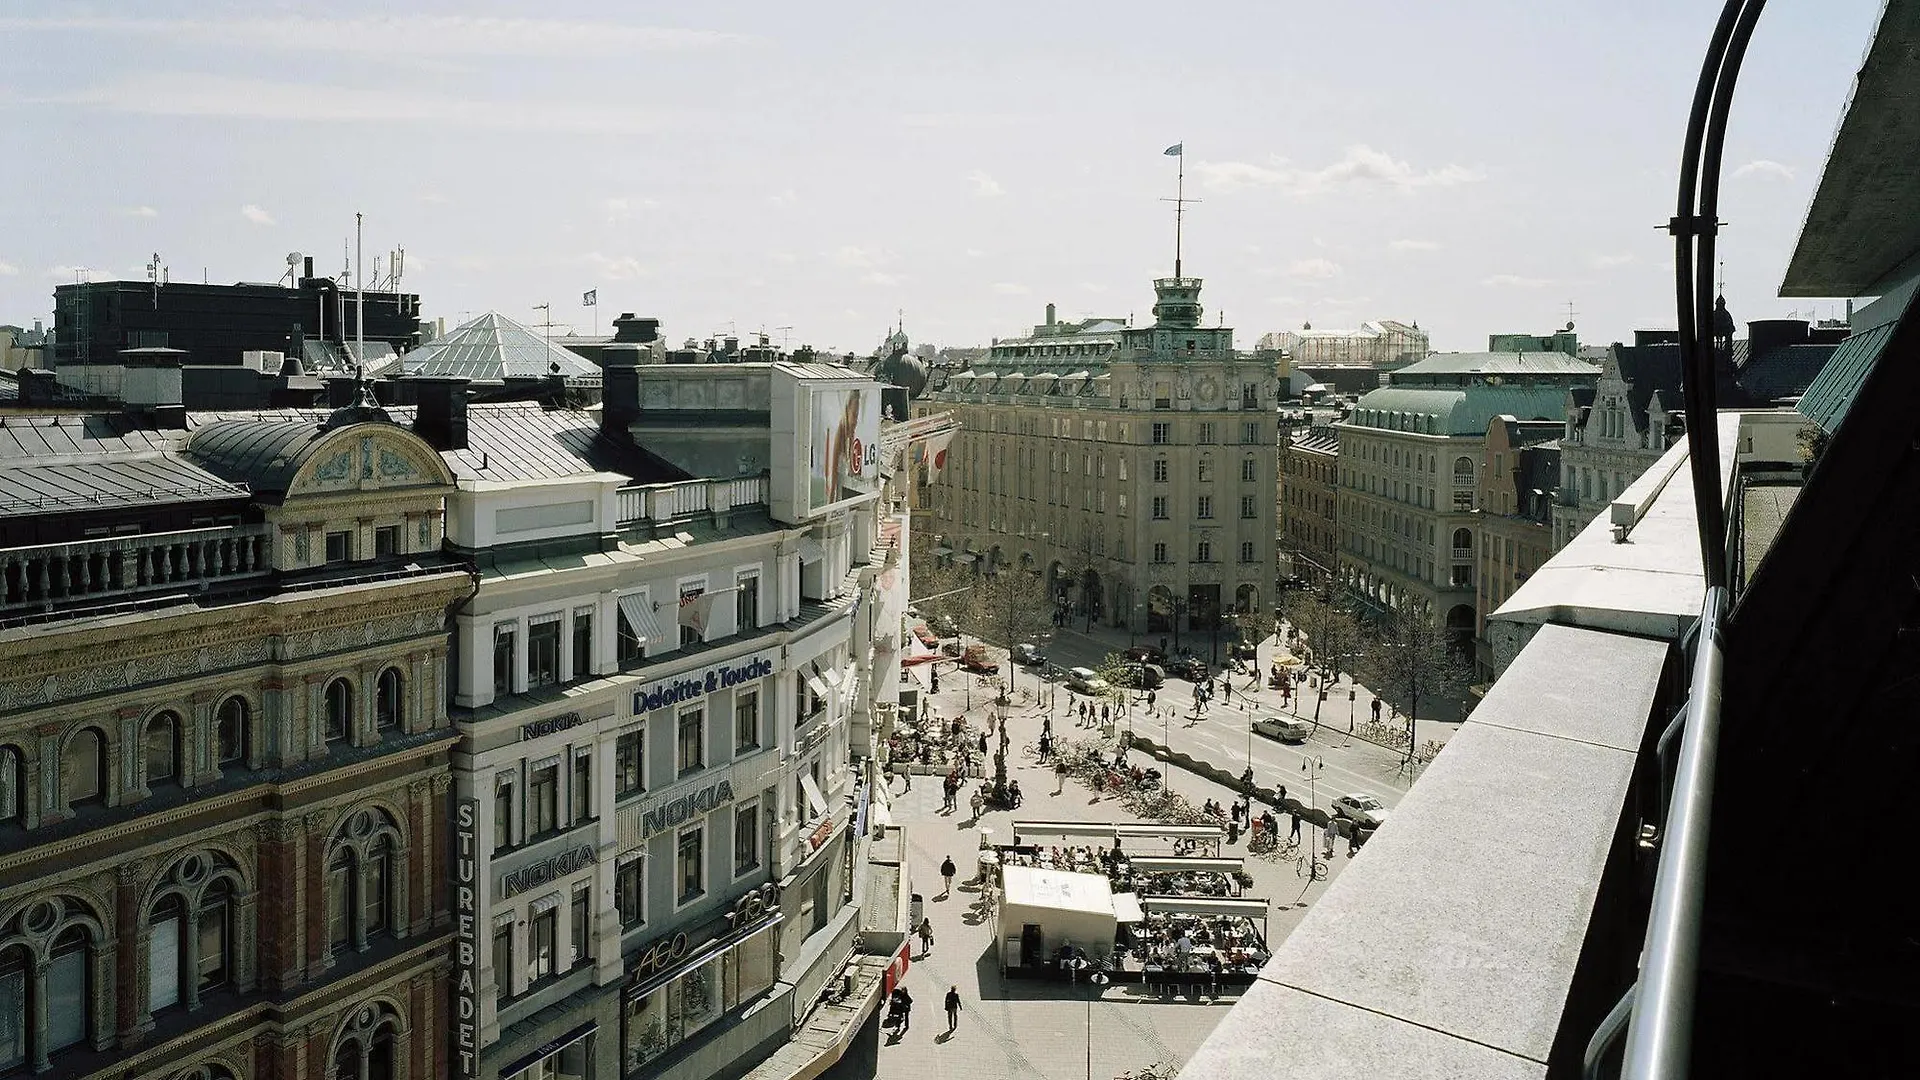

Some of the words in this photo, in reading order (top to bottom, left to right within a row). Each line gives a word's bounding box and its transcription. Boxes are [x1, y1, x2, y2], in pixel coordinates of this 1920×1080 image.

[863, 443, 876, 466] LG
[633, 679, 703, 716] Deloitte
[704, 670, 718, 693] &
[718, 656, 772, 688] Touche
[523, 711, 584, 741] NOKIA
[642, 779, 735, 839] NOKIA
[504, 844, 598, 899] NOKIA
[459, 804, 474, 1074] STUREBADET
[631, 931, 688, 981] AGO
